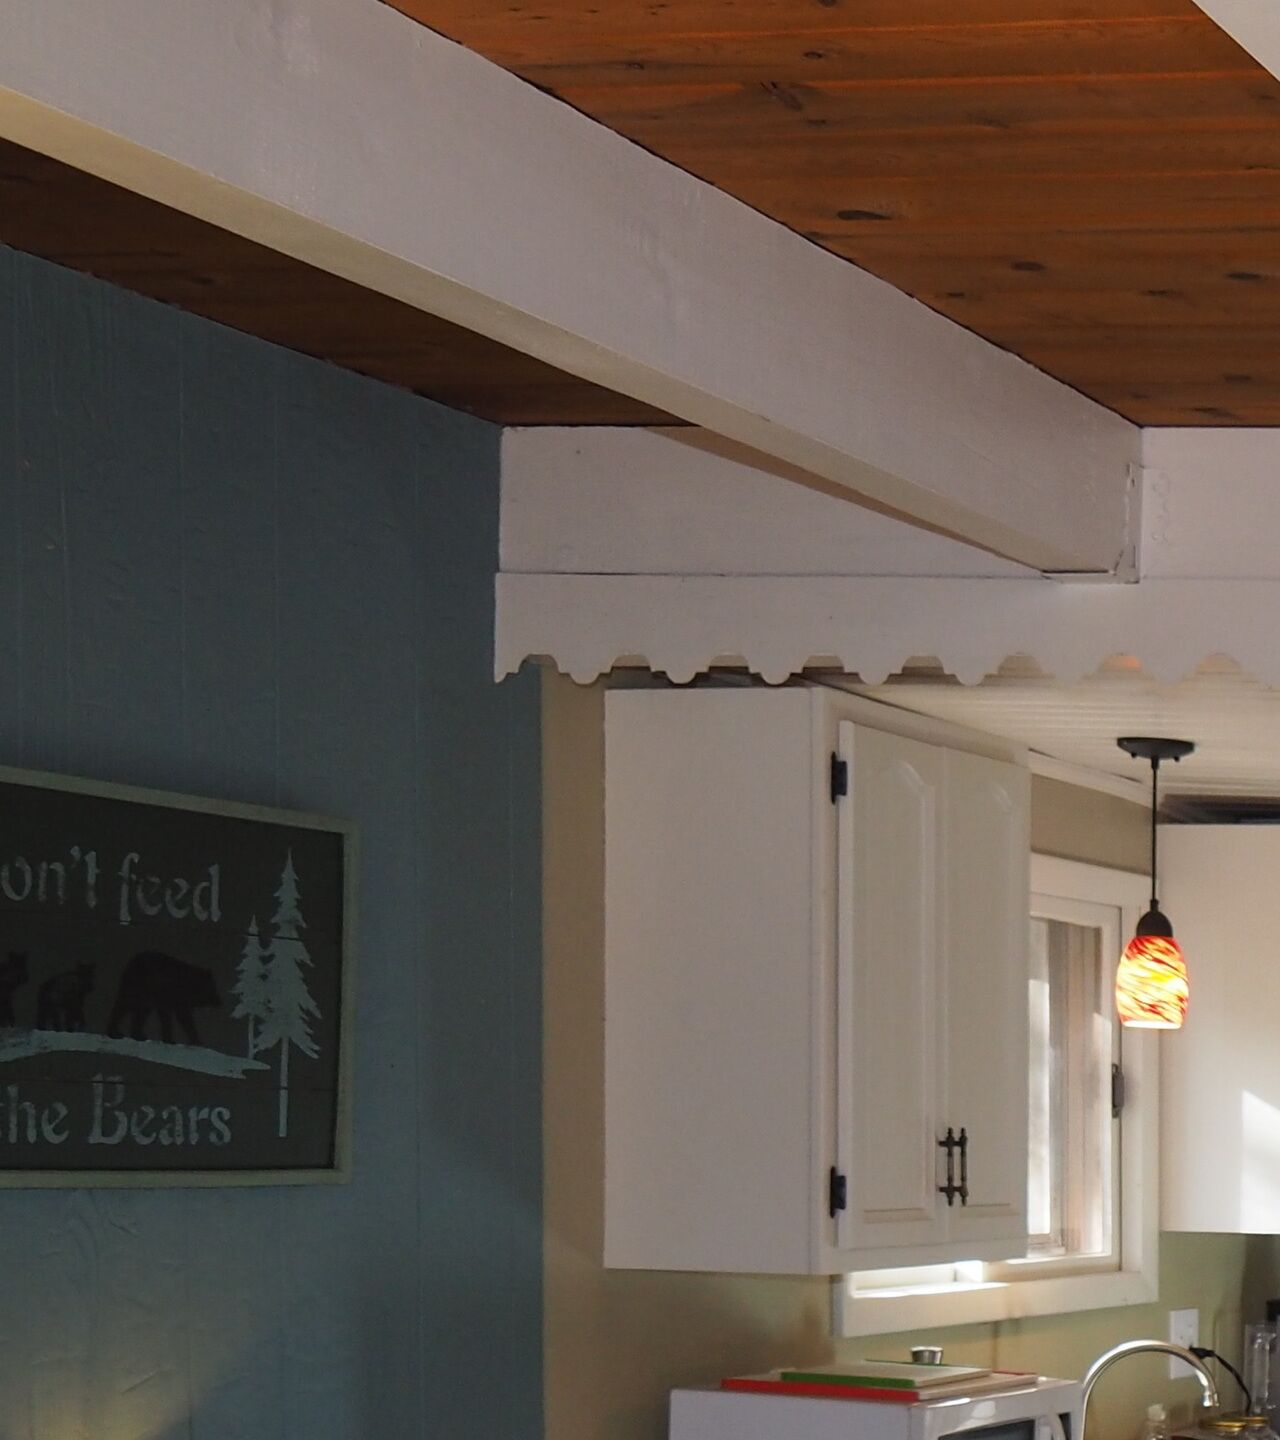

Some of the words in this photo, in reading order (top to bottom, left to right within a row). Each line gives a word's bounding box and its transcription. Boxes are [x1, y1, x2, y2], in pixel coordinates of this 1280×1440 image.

[118, 852, 222, 925] feed
[0, 1083, 69, 1144] he
[87, 1072, 232, 1146] Bears
